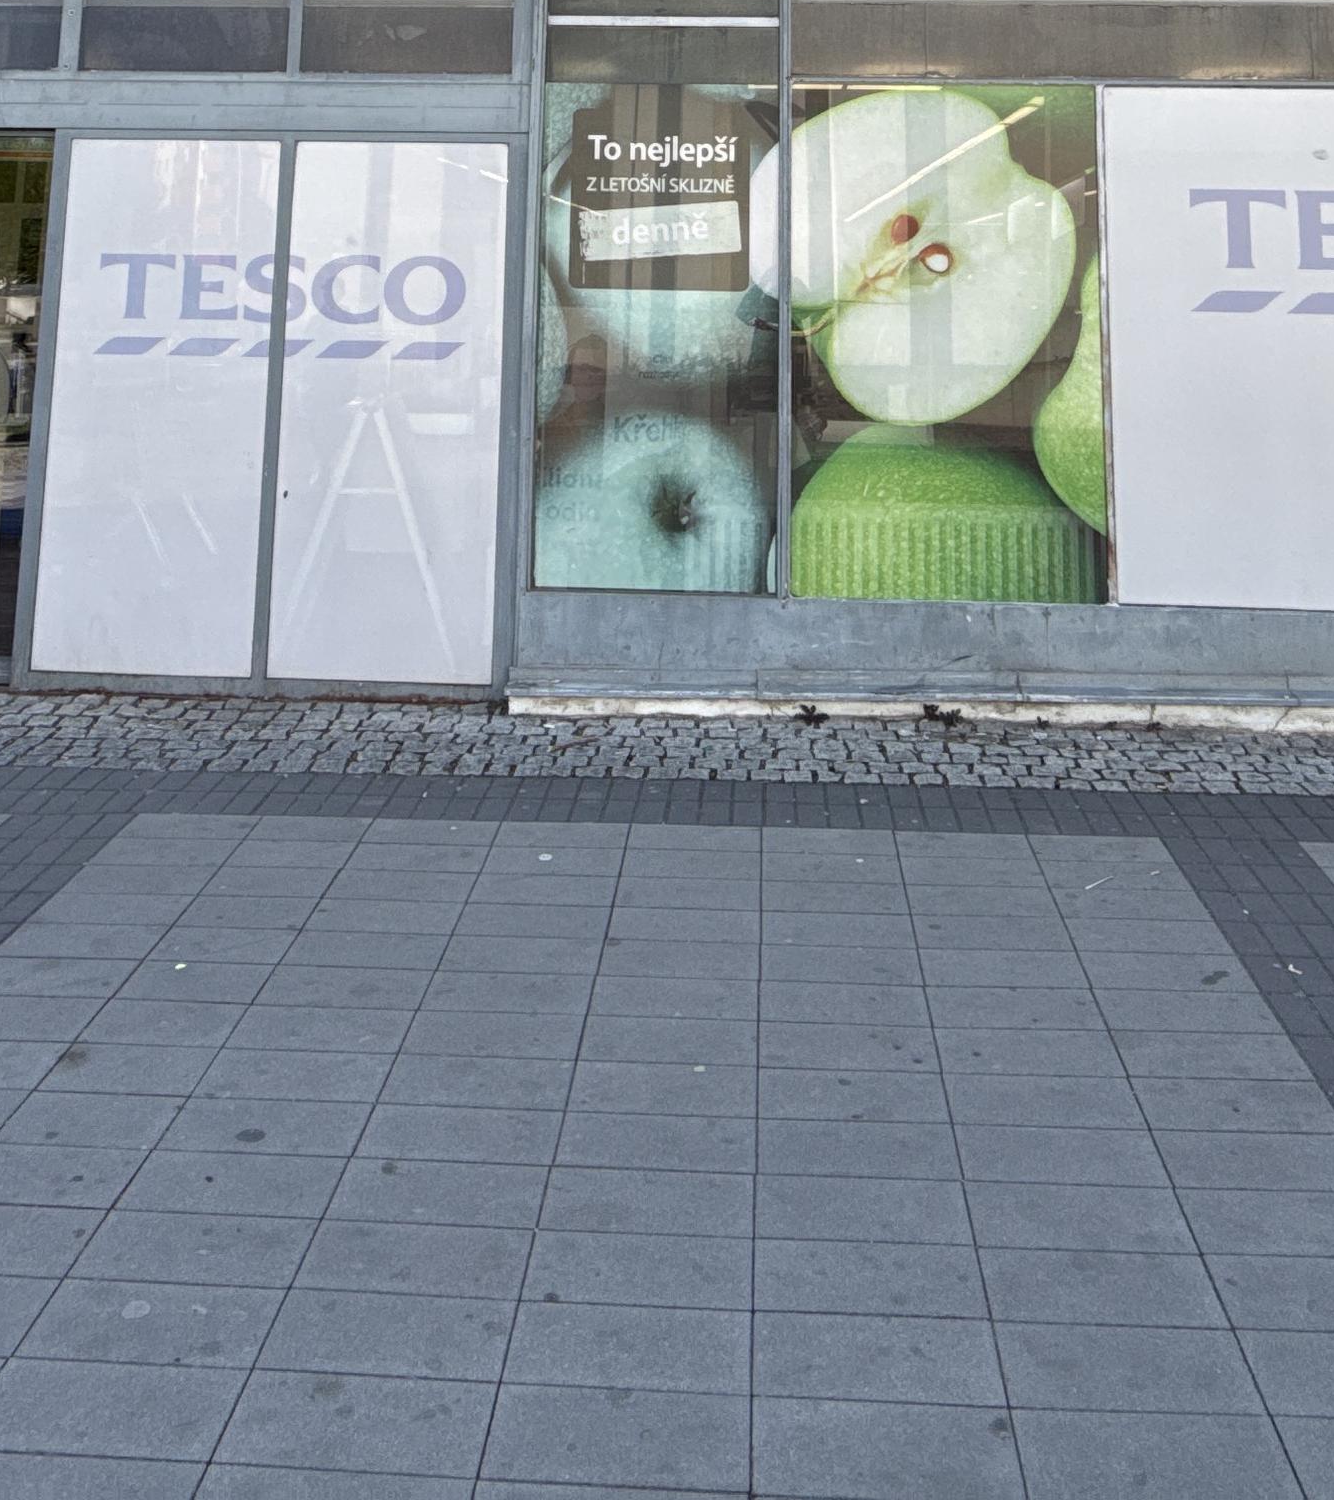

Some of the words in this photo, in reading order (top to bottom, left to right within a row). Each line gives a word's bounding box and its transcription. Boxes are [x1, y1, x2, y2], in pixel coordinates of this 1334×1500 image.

[587, 134, 622, 160] To
[629, 135, 739, 168] nejlepší
[586, 177, 597, 192] Z
[600, 173, 667, 193] LETOŠNÍ
[669, 175, 735, 194] SKLIZNĚ
[612, 211, 709, 244] denně
[99, 253, 467, 325] TESCO
